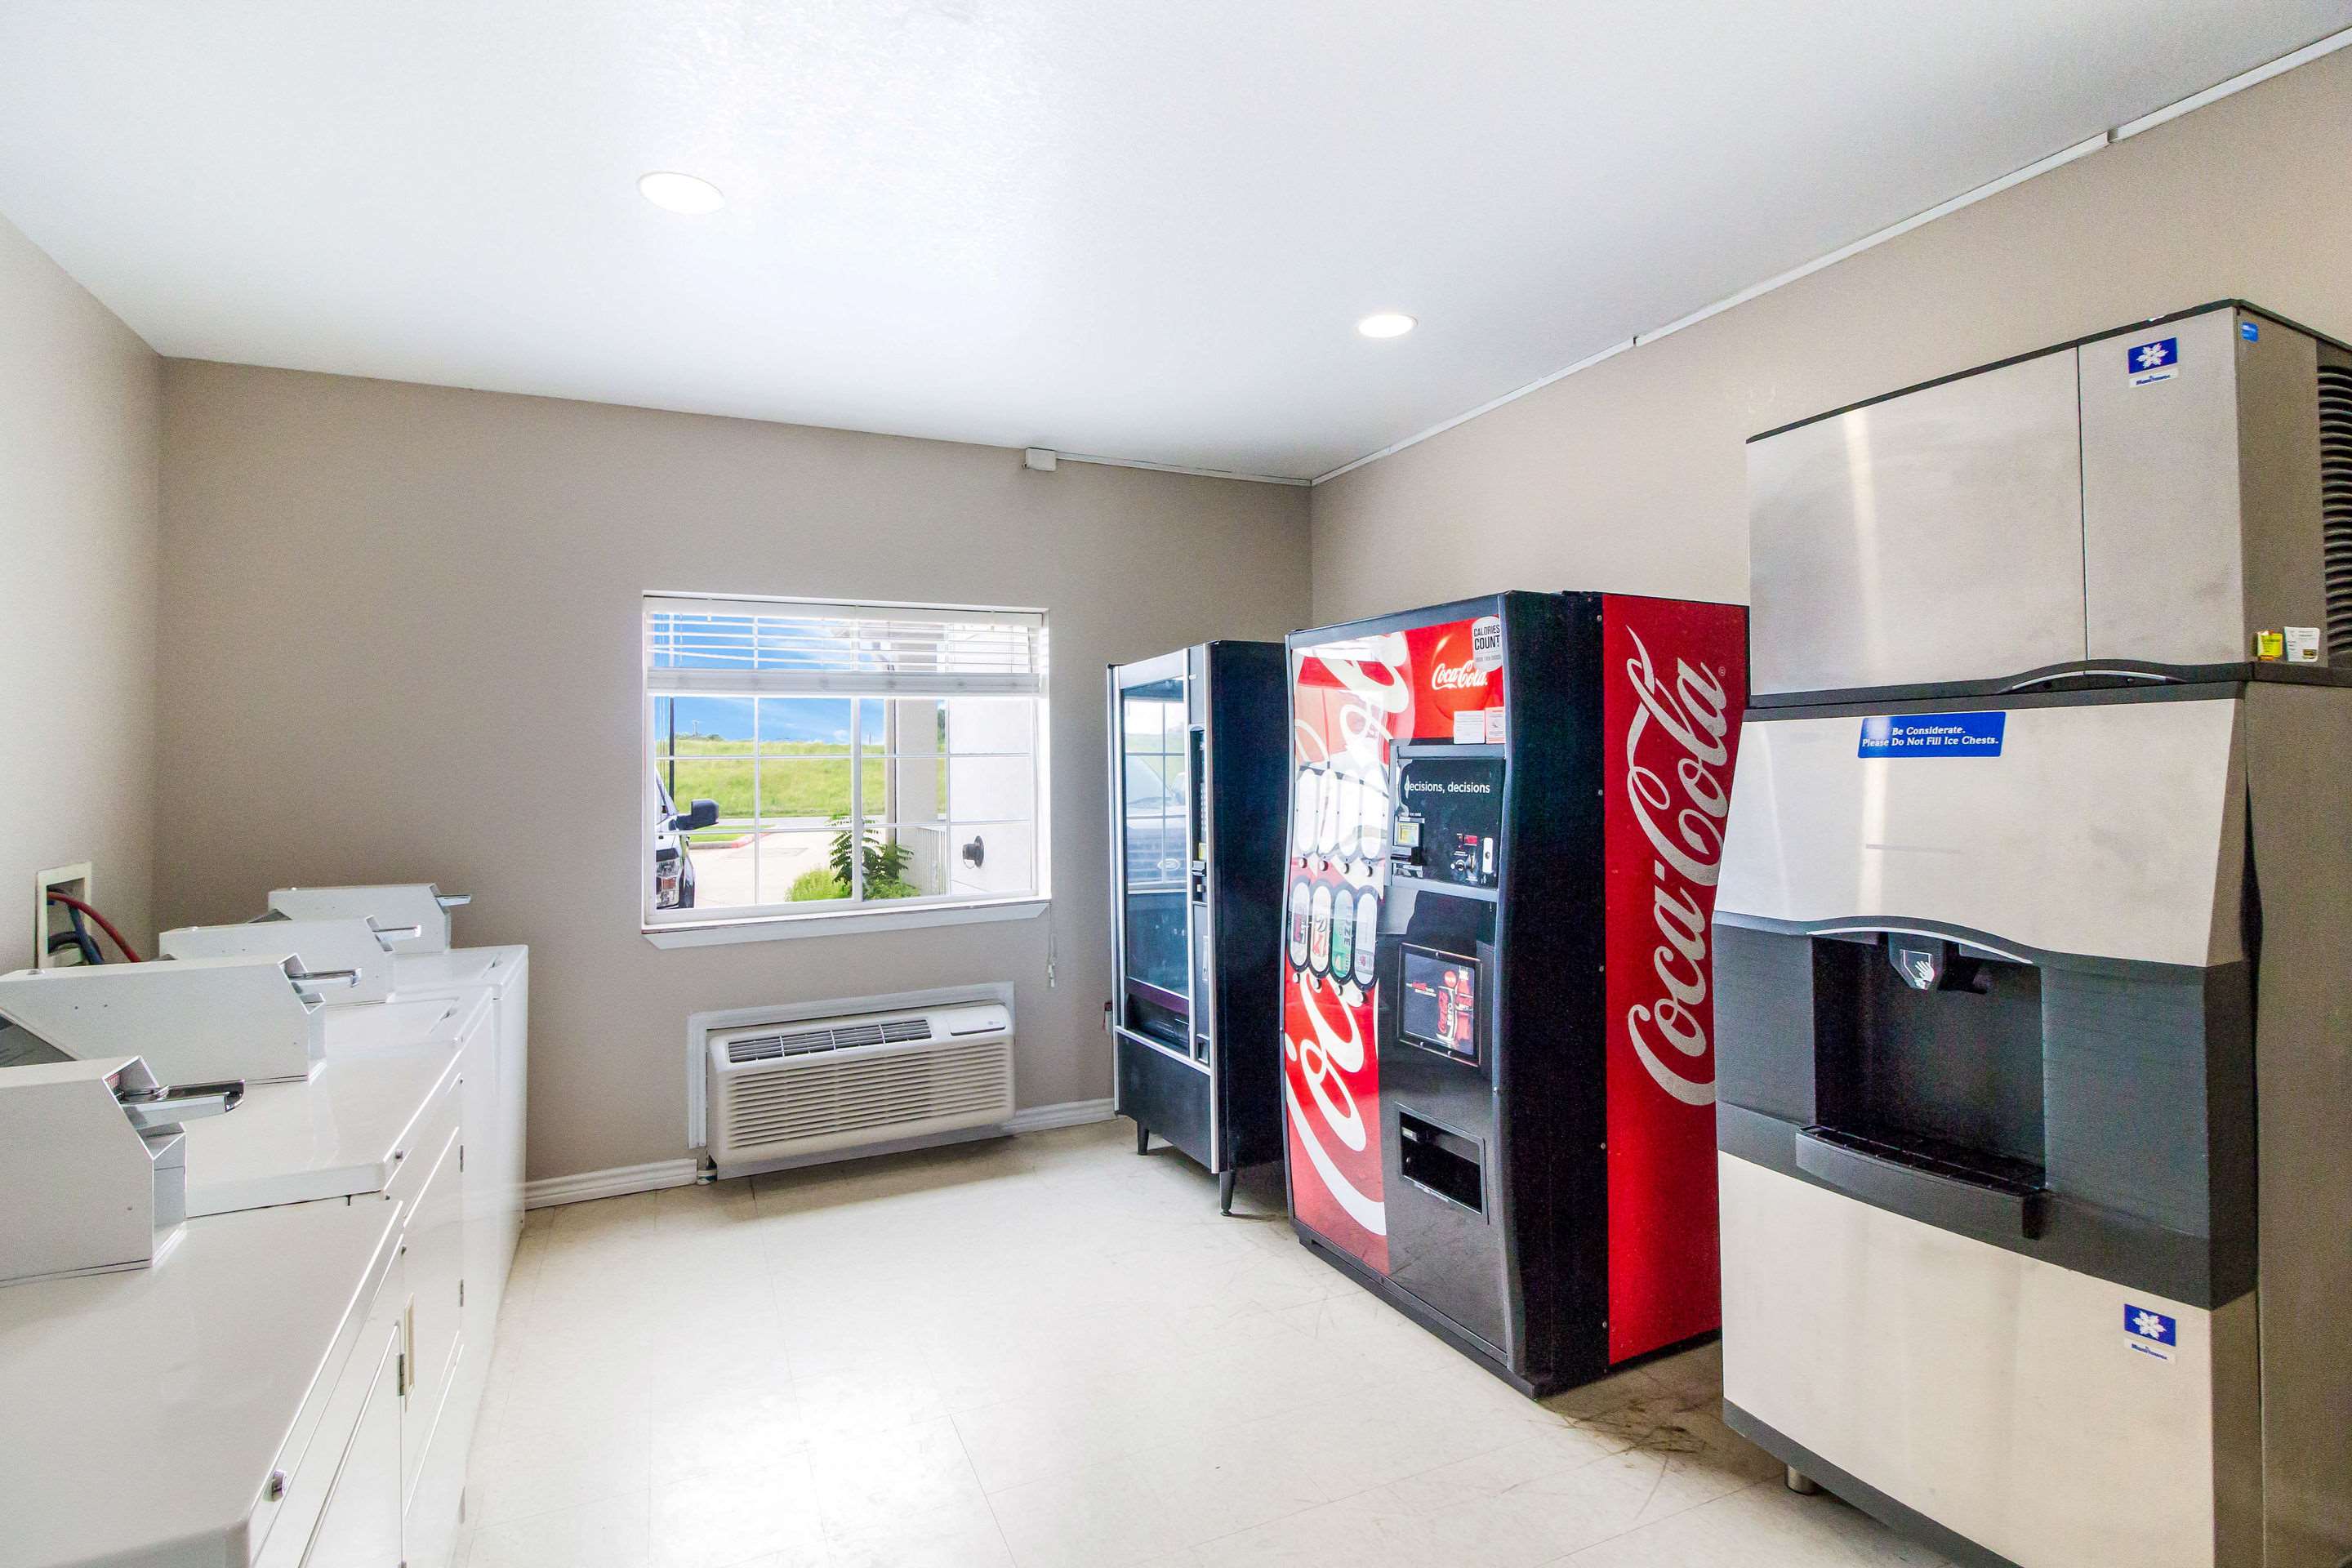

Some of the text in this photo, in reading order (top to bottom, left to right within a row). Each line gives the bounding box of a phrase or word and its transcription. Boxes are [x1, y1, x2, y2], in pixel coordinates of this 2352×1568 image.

[1473, 625, 1500, 637] CALORIES
[1474, 635, 1500, 650] COUNT
[1891, 726, 1966, 736] Be Considerate.
[1861, 735, 1999, 747] Please Do Not Fill Ice Chests.
[1405, 780, 1490, 794] decisions, decisions
[1626, 625, 1728, 1105] Coca-Cola
